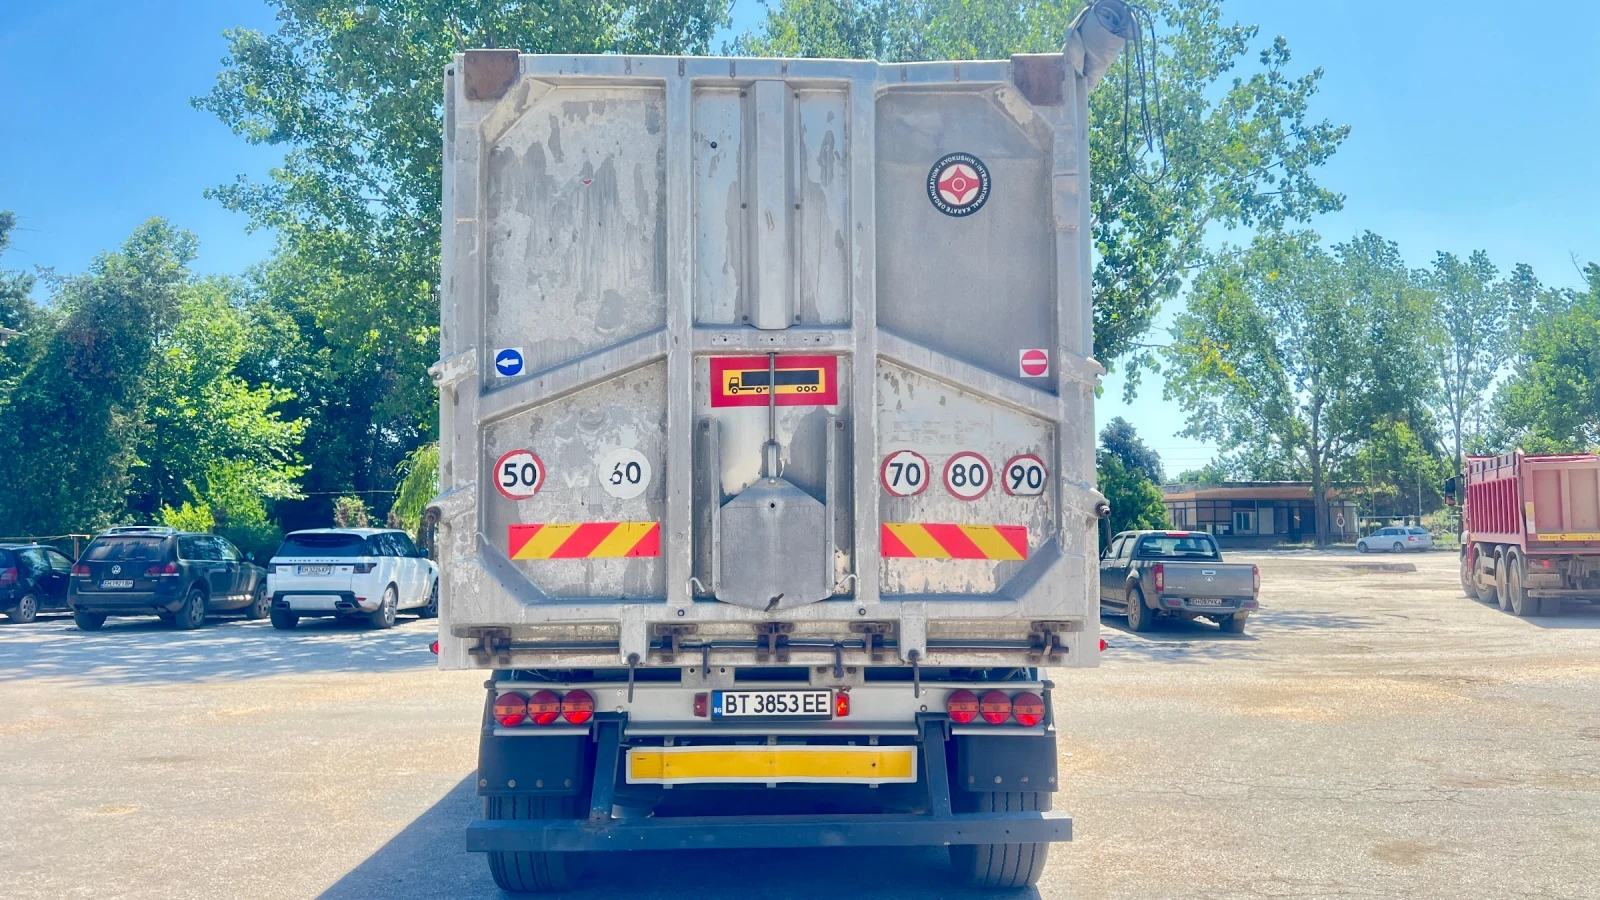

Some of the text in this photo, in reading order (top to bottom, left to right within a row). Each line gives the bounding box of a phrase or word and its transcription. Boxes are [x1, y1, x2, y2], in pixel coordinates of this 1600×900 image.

[940, 155, 976, 167] KYOKUSHIN
[929, 168, 946, 210] ORGANIZATION
[971, 165, 989, 209] INTERNATIONAL
[502, 462, 537, 488] 50
[889, 462, 921, 487] 70
[951, 463, 984, 488] 80
[1009, 464, 1043, 490] 90
[725, 694, 828, 714] BT 3853 EE
